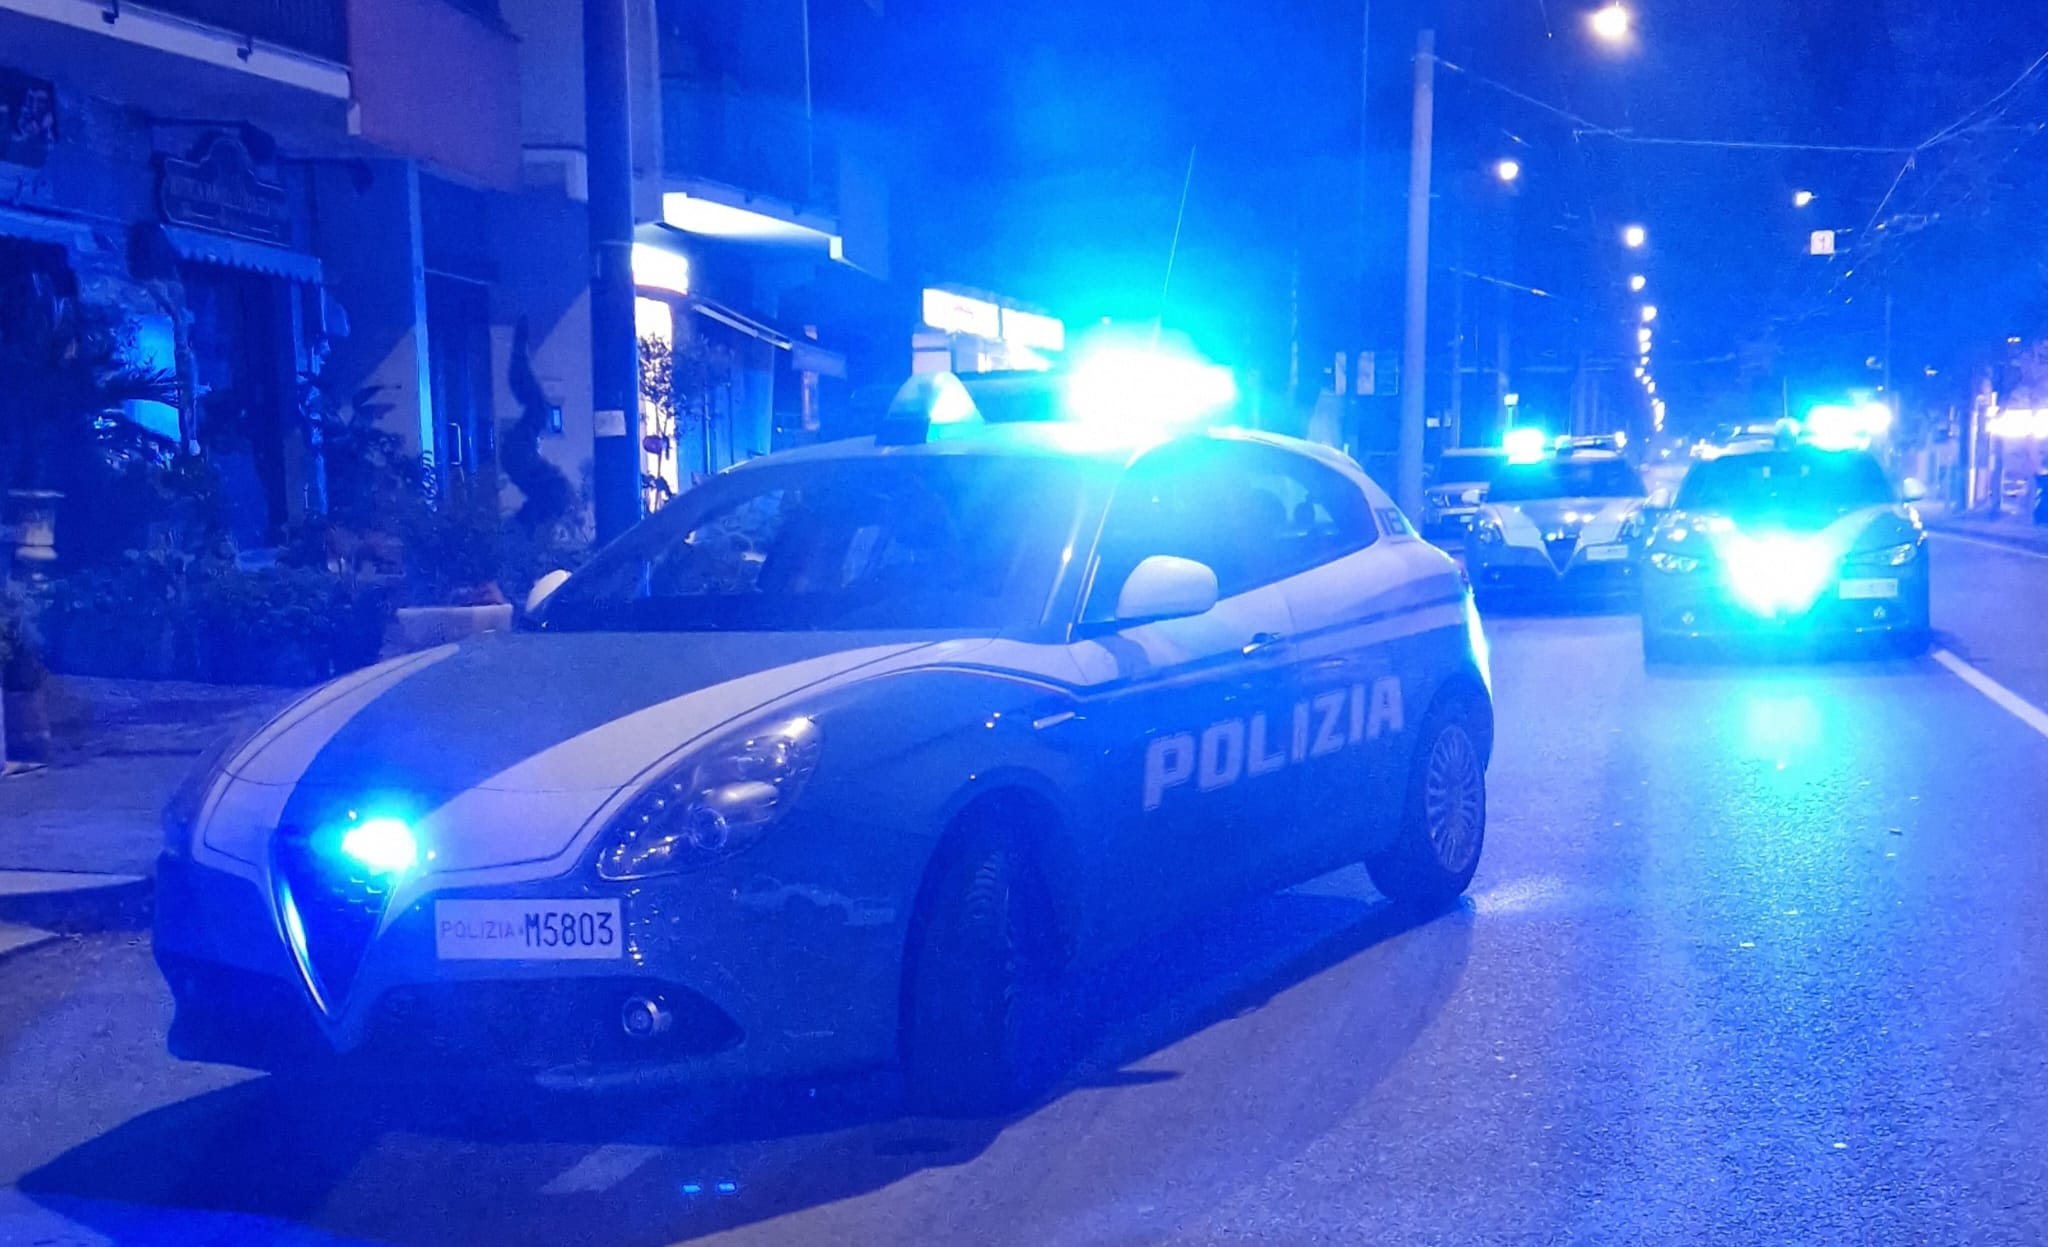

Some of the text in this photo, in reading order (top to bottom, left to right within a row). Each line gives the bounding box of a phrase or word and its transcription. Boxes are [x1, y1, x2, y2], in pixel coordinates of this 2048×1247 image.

[1143, 675, 1404, 811] POLIZIA
[441, 912, 614, 947] POLIZIA M5803
